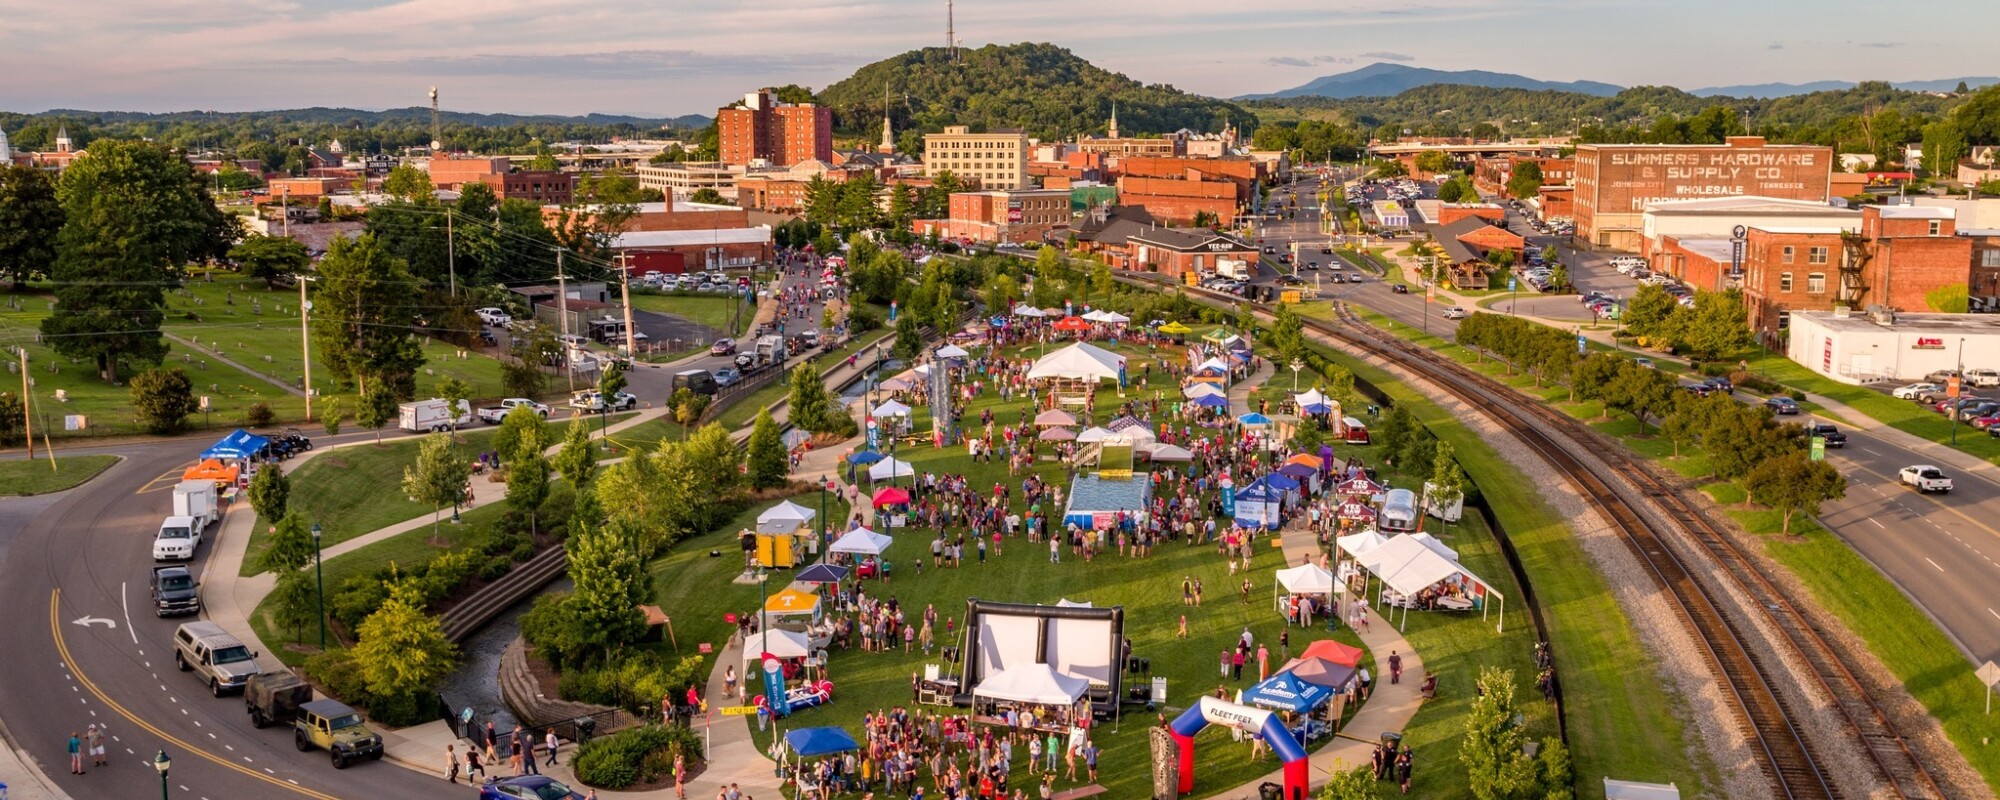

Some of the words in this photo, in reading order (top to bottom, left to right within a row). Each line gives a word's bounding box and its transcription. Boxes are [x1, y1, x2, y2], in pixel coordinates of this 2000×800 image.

[1611, 153, 1699, 166] SUMMERS
[1710, 153, 1814, 166] HARDWARE
[1642, 167, 1656, 178] &
[1667, 167, 1741, 179] SUPPLY
[1755, 167, 1784, 179] CO.
[1676, 185, 1744, 195] WHOLESALE
[781, 595, 796, 607] T
[1260, 687, 1297, 698] Academy
[1253, 697, 1296, 709] academy.com
[723, 706, 757, 716] FINISH
[1210, 708, 1233, 720] FLEET
[1233, 713, 1253, 725] FEET
